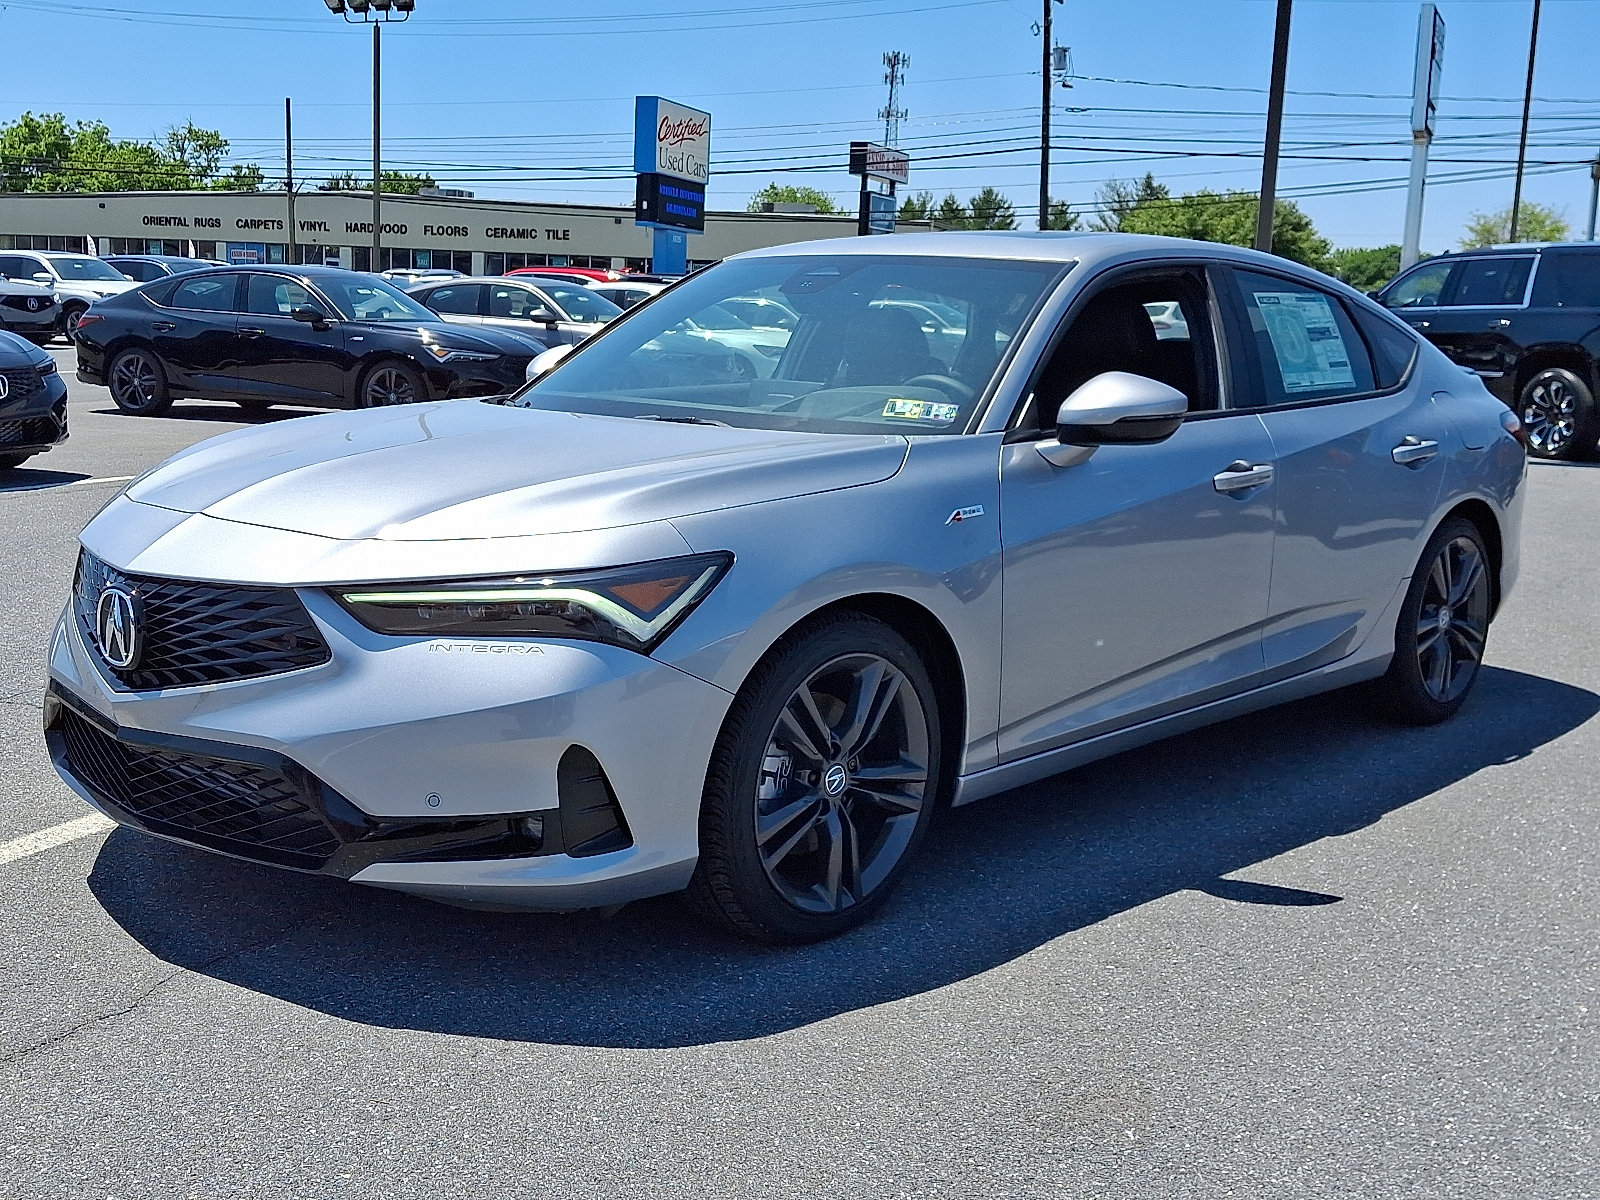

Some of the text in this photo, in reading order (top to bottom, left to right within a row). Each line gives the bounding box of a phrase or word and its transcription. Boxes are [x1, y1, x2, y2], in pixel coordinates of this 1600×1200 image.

[658, 115, 710, 147] Certified
[659, 147, 708, 179] Used Cars
[142, 215, 189, 227] ORIENTAL
[194, 217, 222, 228] RUGS
[236, 219, 284, 230] CARPETS
[299, 220, 331, 232] VINYL
[424, 226, 469, 237] FLOORS
[486, 227, 538, 240] CERAMIC
[545, 229, 571, 241] TILE
[428, 644, 546, 655] INTEGRA
